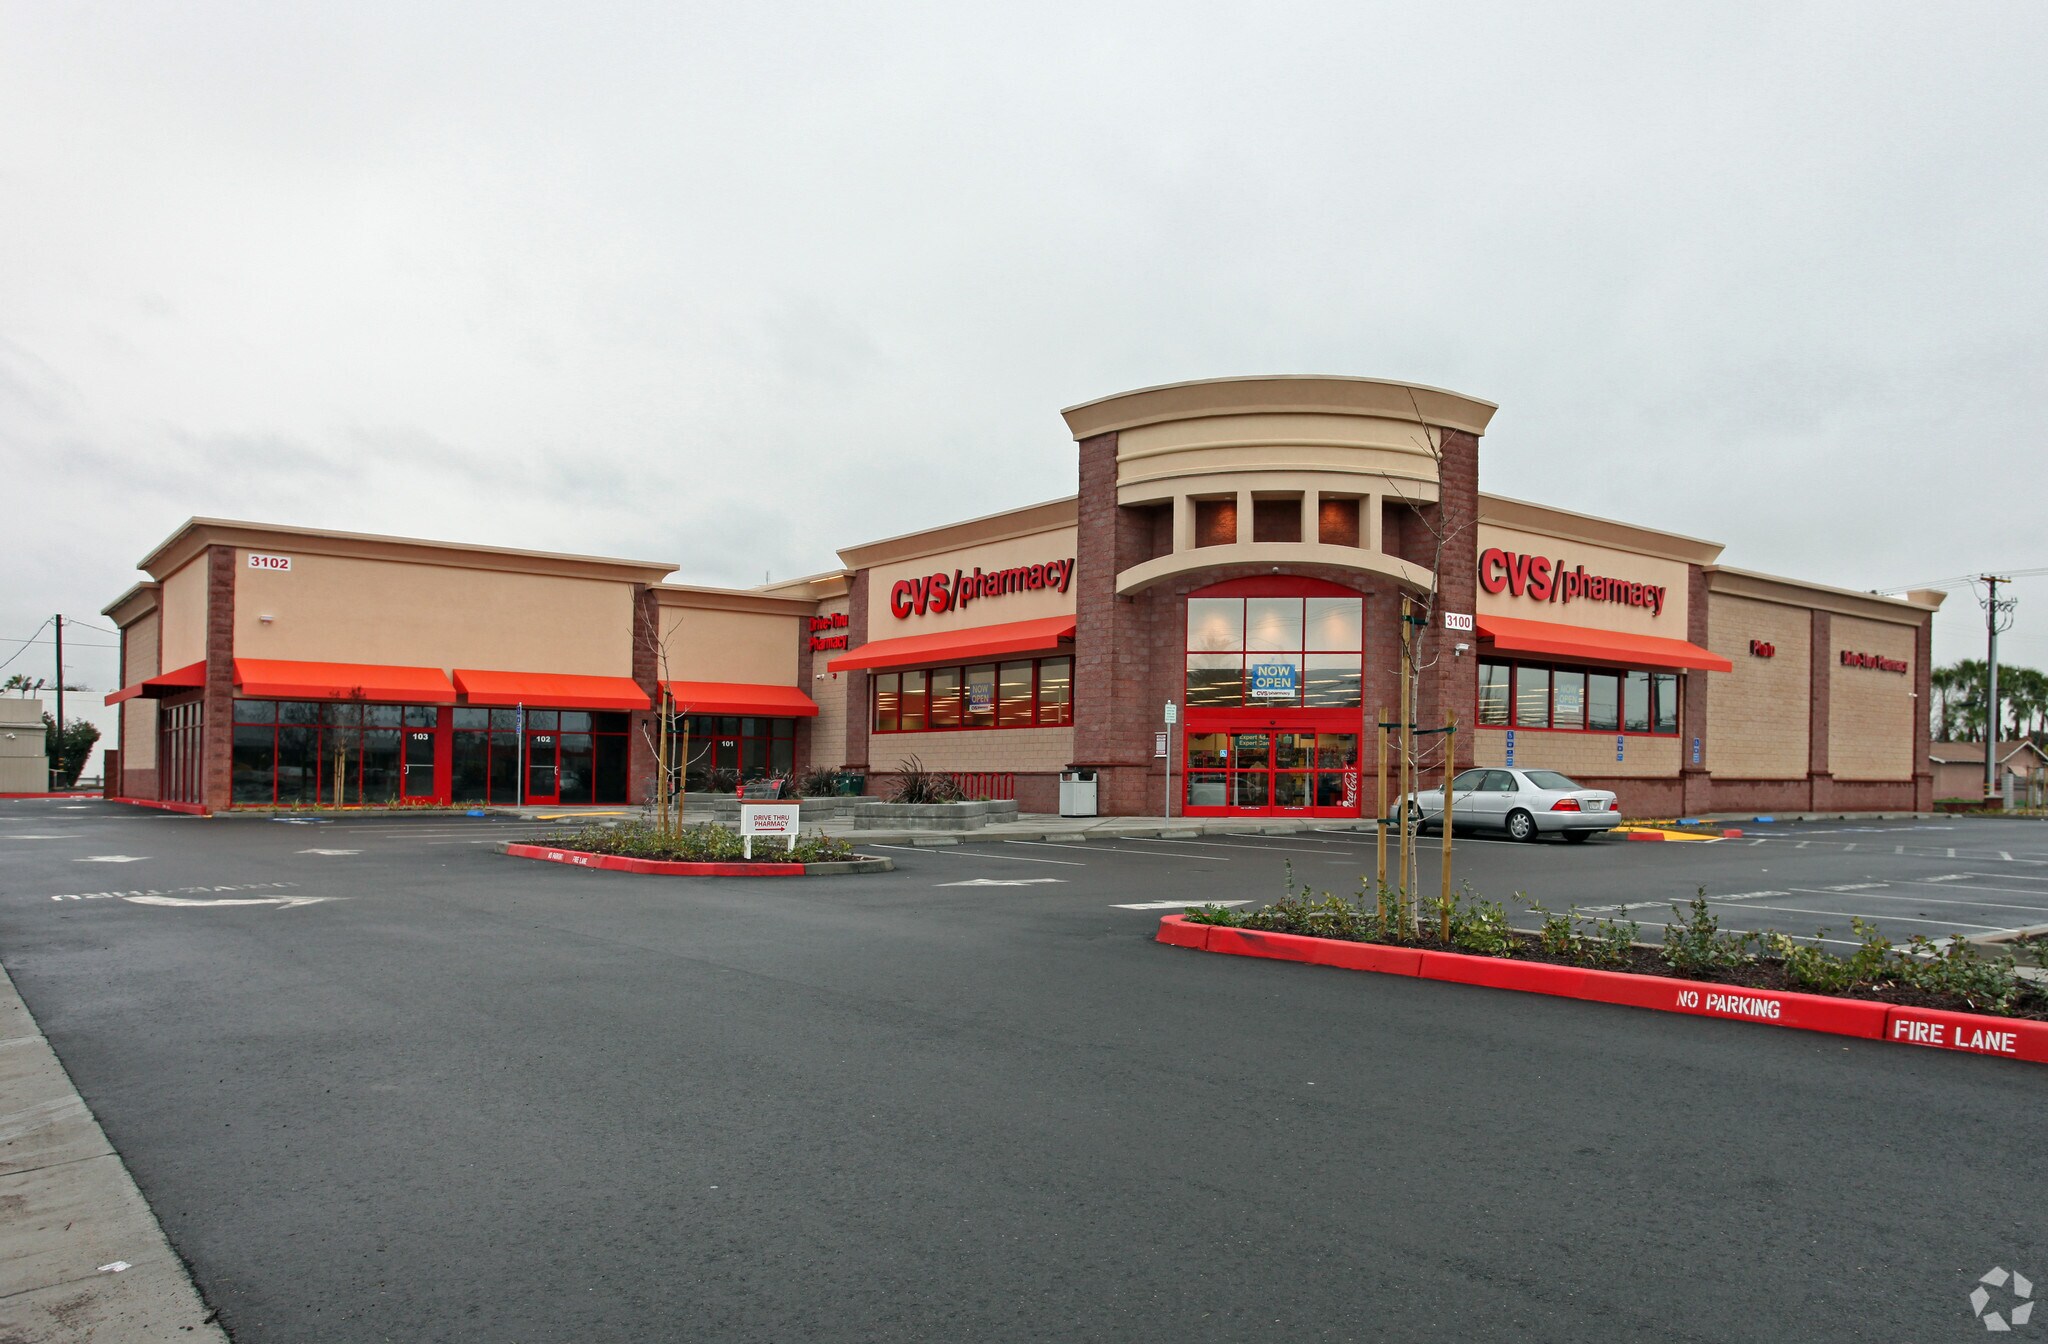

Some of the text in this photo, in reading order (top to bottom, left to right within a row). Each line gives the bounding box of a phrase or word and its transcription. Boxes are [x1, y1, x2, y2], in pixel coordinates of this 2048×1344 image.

[251, 556, 289, 569] 3102
[890, 557, 1076, 620] CVS/pharmacy
[1478, 547, 1667, 617] CVS/pharmacy
[1447, 615, 1471, 628] 3100
[1258, 666, 1291, 676] NOW
[972, 685, 989, 693] NOW
[1256, 677, 1291, 688] OPEN
[971, 694, 989, 703] OPEN
[412, 733, 428, 741] 103
[1676, 990, 1781, 1019] NO PARKING
[1894, 1019, 2017, 1053] FIRE LANE
